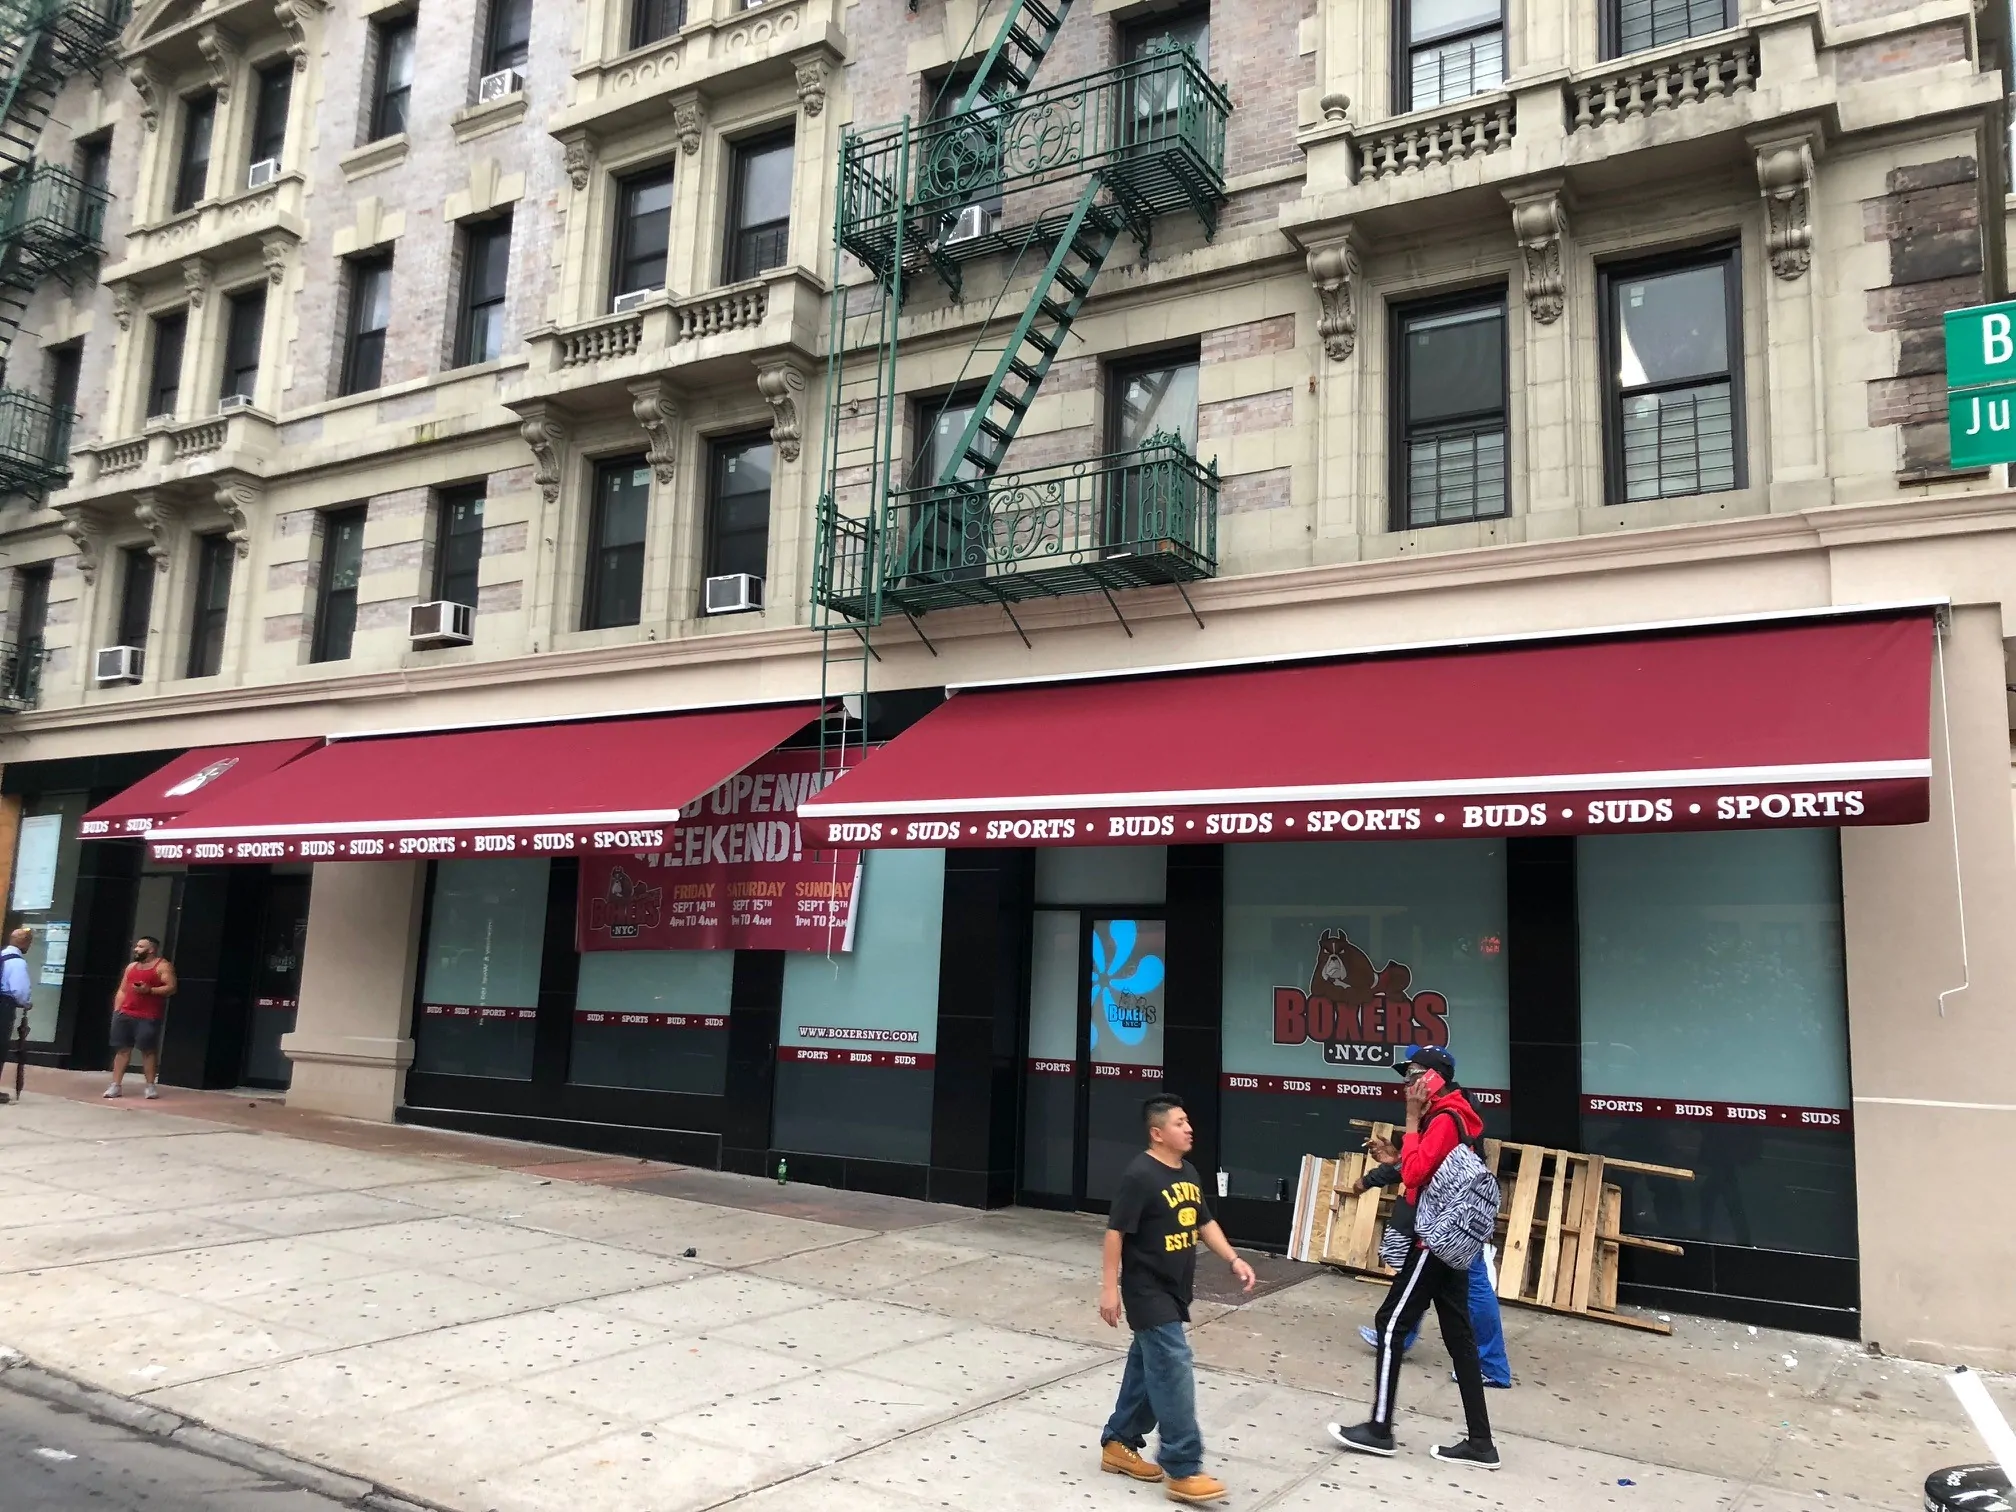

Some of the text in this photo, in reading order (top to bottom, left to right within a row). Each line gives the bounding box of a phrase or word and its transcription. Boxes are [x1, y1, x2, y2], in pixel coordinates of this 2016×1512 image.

[828, 790, 1865, 843] BUDS SUDS SPORTS BUDS SUDS SPORTS BUDS SUDS SPORTS
[82, 818, 153, 833] BUDS SUDS
[153, 829, 664, 859] BUDS SUDS SPORTS BUDS SUDS SPORTS BUDS SUDS SPORTS
[635, 821, 802, 867] EEKEND!
[673, 883, 716, 899] FRIDAY
[727, 881, 787, 897] SATURDAY
[795, 881, 853, 898] SUNDAY
[672, 902, 694, 913] SEPT
[732, 900, 749, 911] SEPT
[797, 900, 825, 912] SEPT
[686, 915, 696, 926] TO
[741, 914, 751, 926] TO
[813, 915, 826, 927] TO
[614, 925, 635, 935] NYC
[426, 1006, 537, 1019] BUDS SUDS SPORTS BUDS
[587, 1013, 724, 1028] SUDS SPORTS BUDS SUDS
[1108, 1003, 1156, 1024] BOXERS
[1272, 986, 1450, 1048] BOXERS
[798, 1026, 919, 1043] WWW.BOXERSNYC.COM
[797, 1050, 916, 1066] SPORTS BUDS SUDS
[1334, 1043, 1383, 1062] NYC
[1035, 1061, 1071, 1073] SPORTS
[1095, 1066, 1121, 1076] BUDS
[1229, 1077, 1502, 1104] BUDS SUDS SPORTS UDS
[1590, 1099, 1841, 1125] SPORTS BUDS BUDS SUDS
